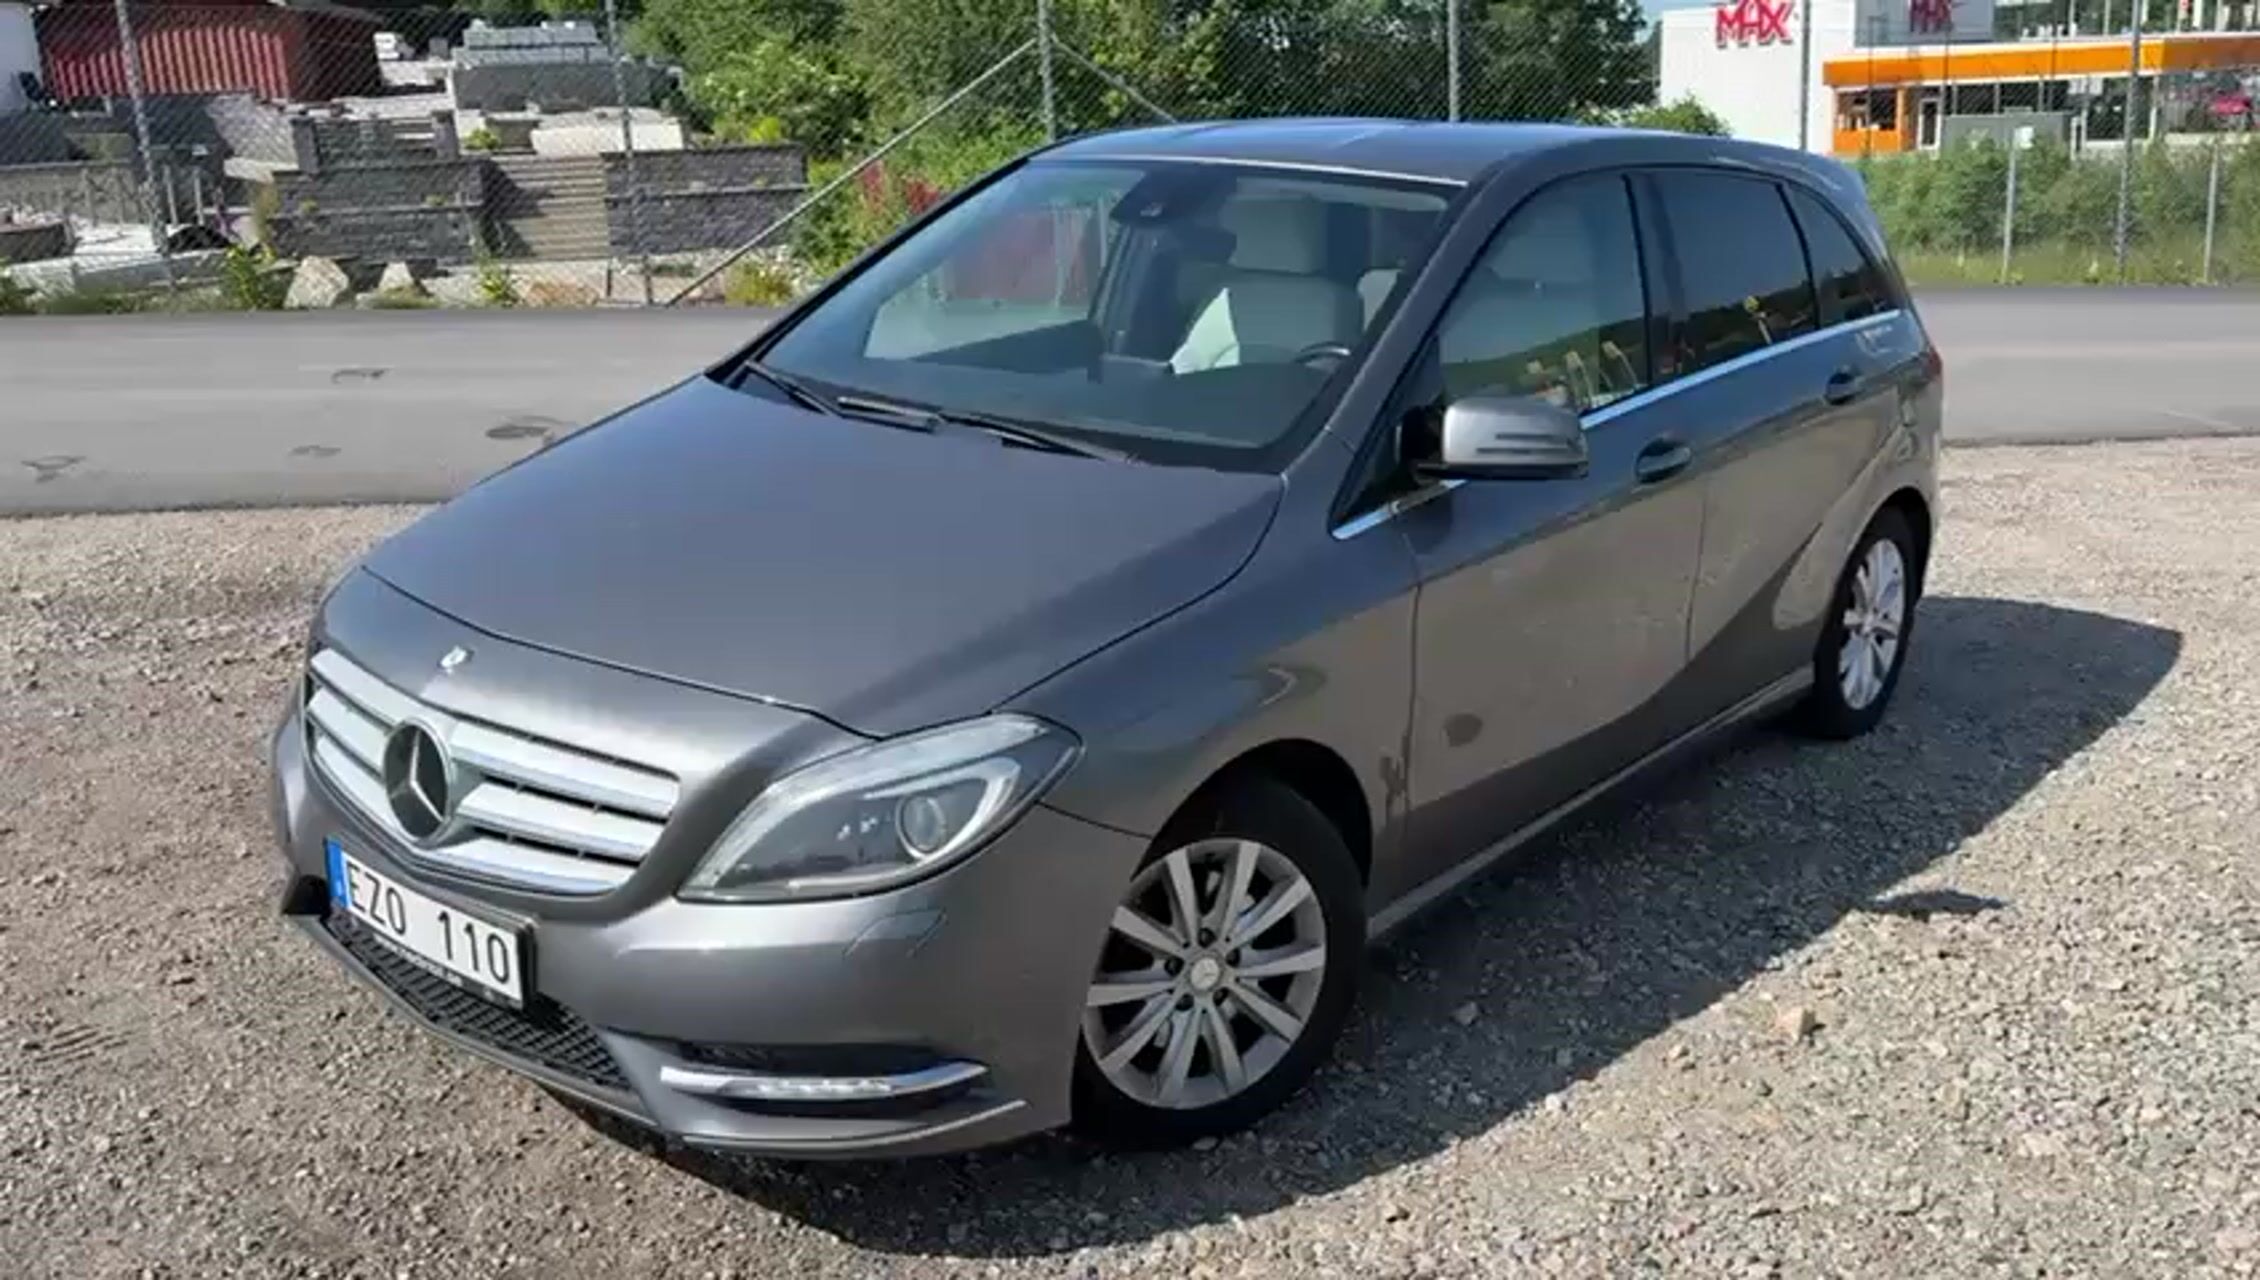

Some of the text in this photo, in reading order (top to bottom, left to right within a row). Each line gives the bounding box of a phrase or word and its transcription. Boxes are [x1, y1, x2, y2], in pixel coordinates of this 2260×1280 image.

[1716, 0, 1792, 45] MAX
[347, 861, 406, 935] EZO
[438, 911, 510, 984] 110
